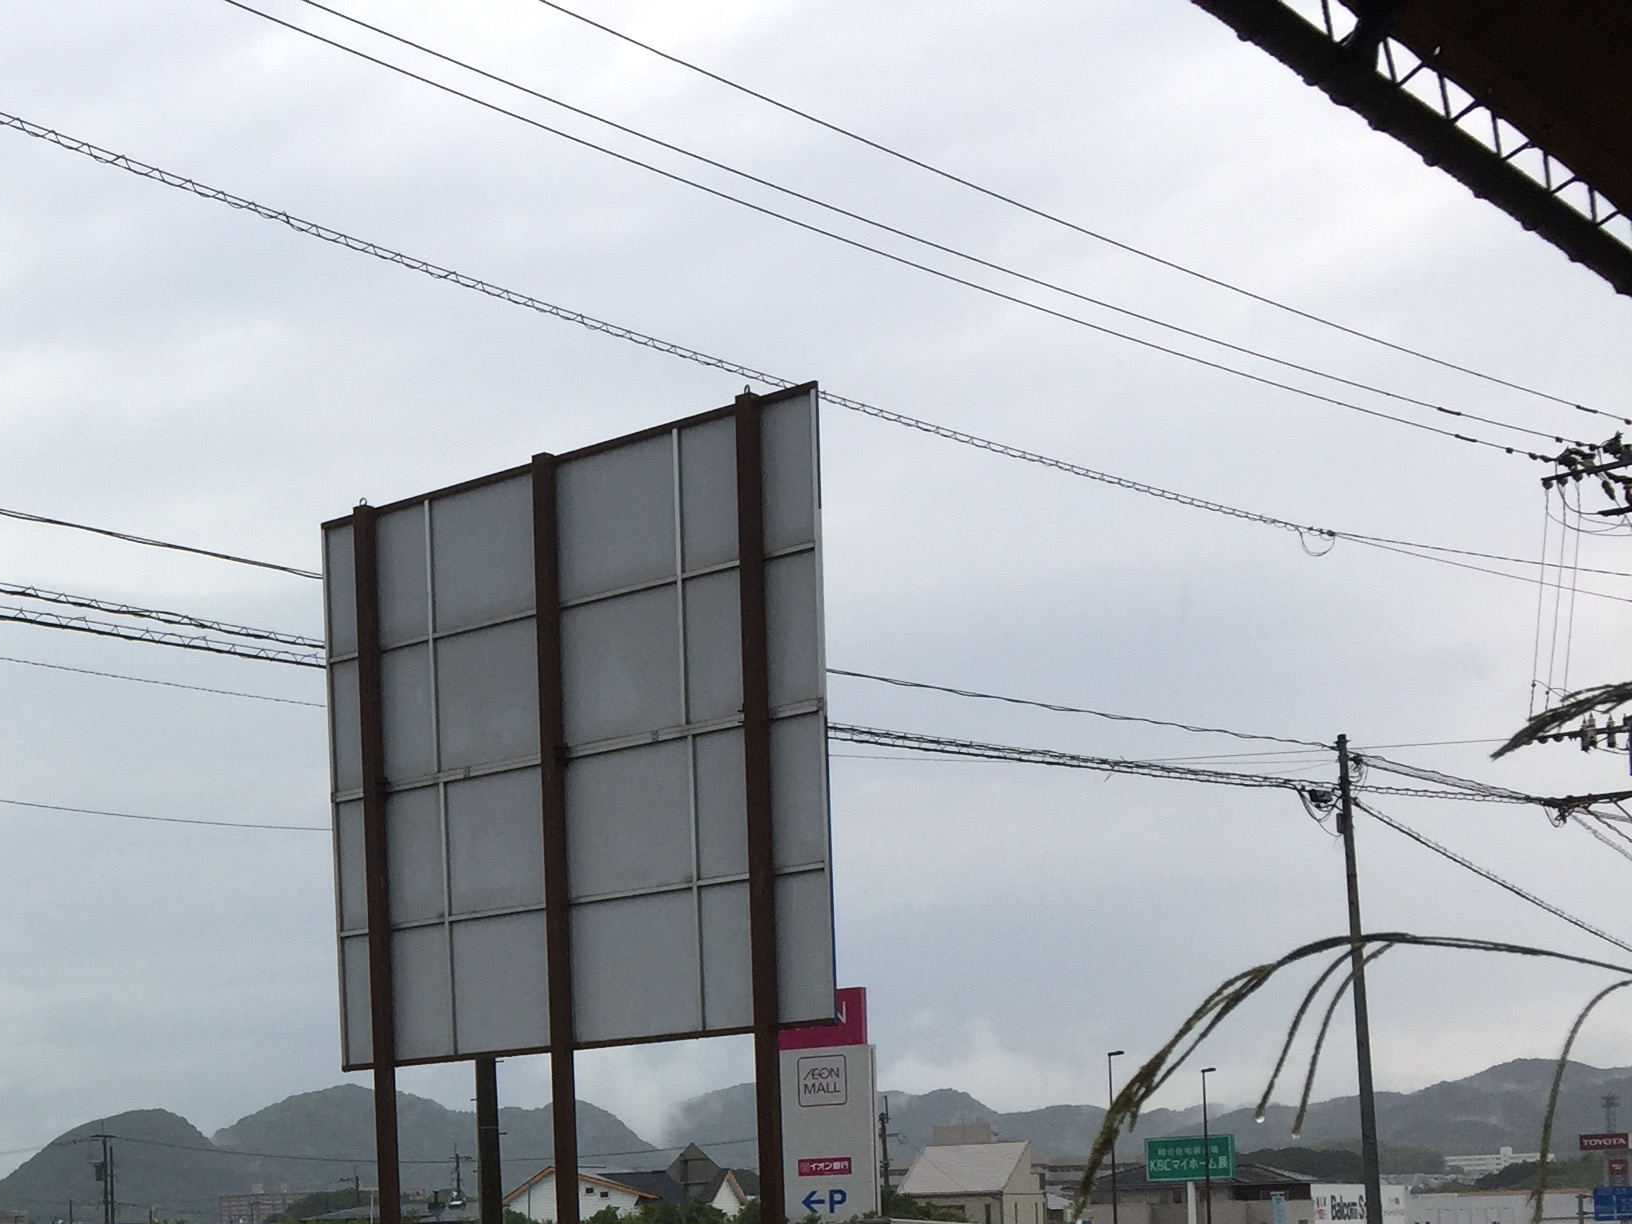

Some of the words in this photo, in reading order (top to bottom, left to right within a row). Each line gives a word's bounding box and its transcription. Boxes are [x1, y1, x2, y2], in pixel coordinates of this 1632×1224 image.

[803, 1082, 841, 1094] MALL
[1582, 1138, 1626, 1146] TOYOTA
[829, 1189, 847, 1214] P
